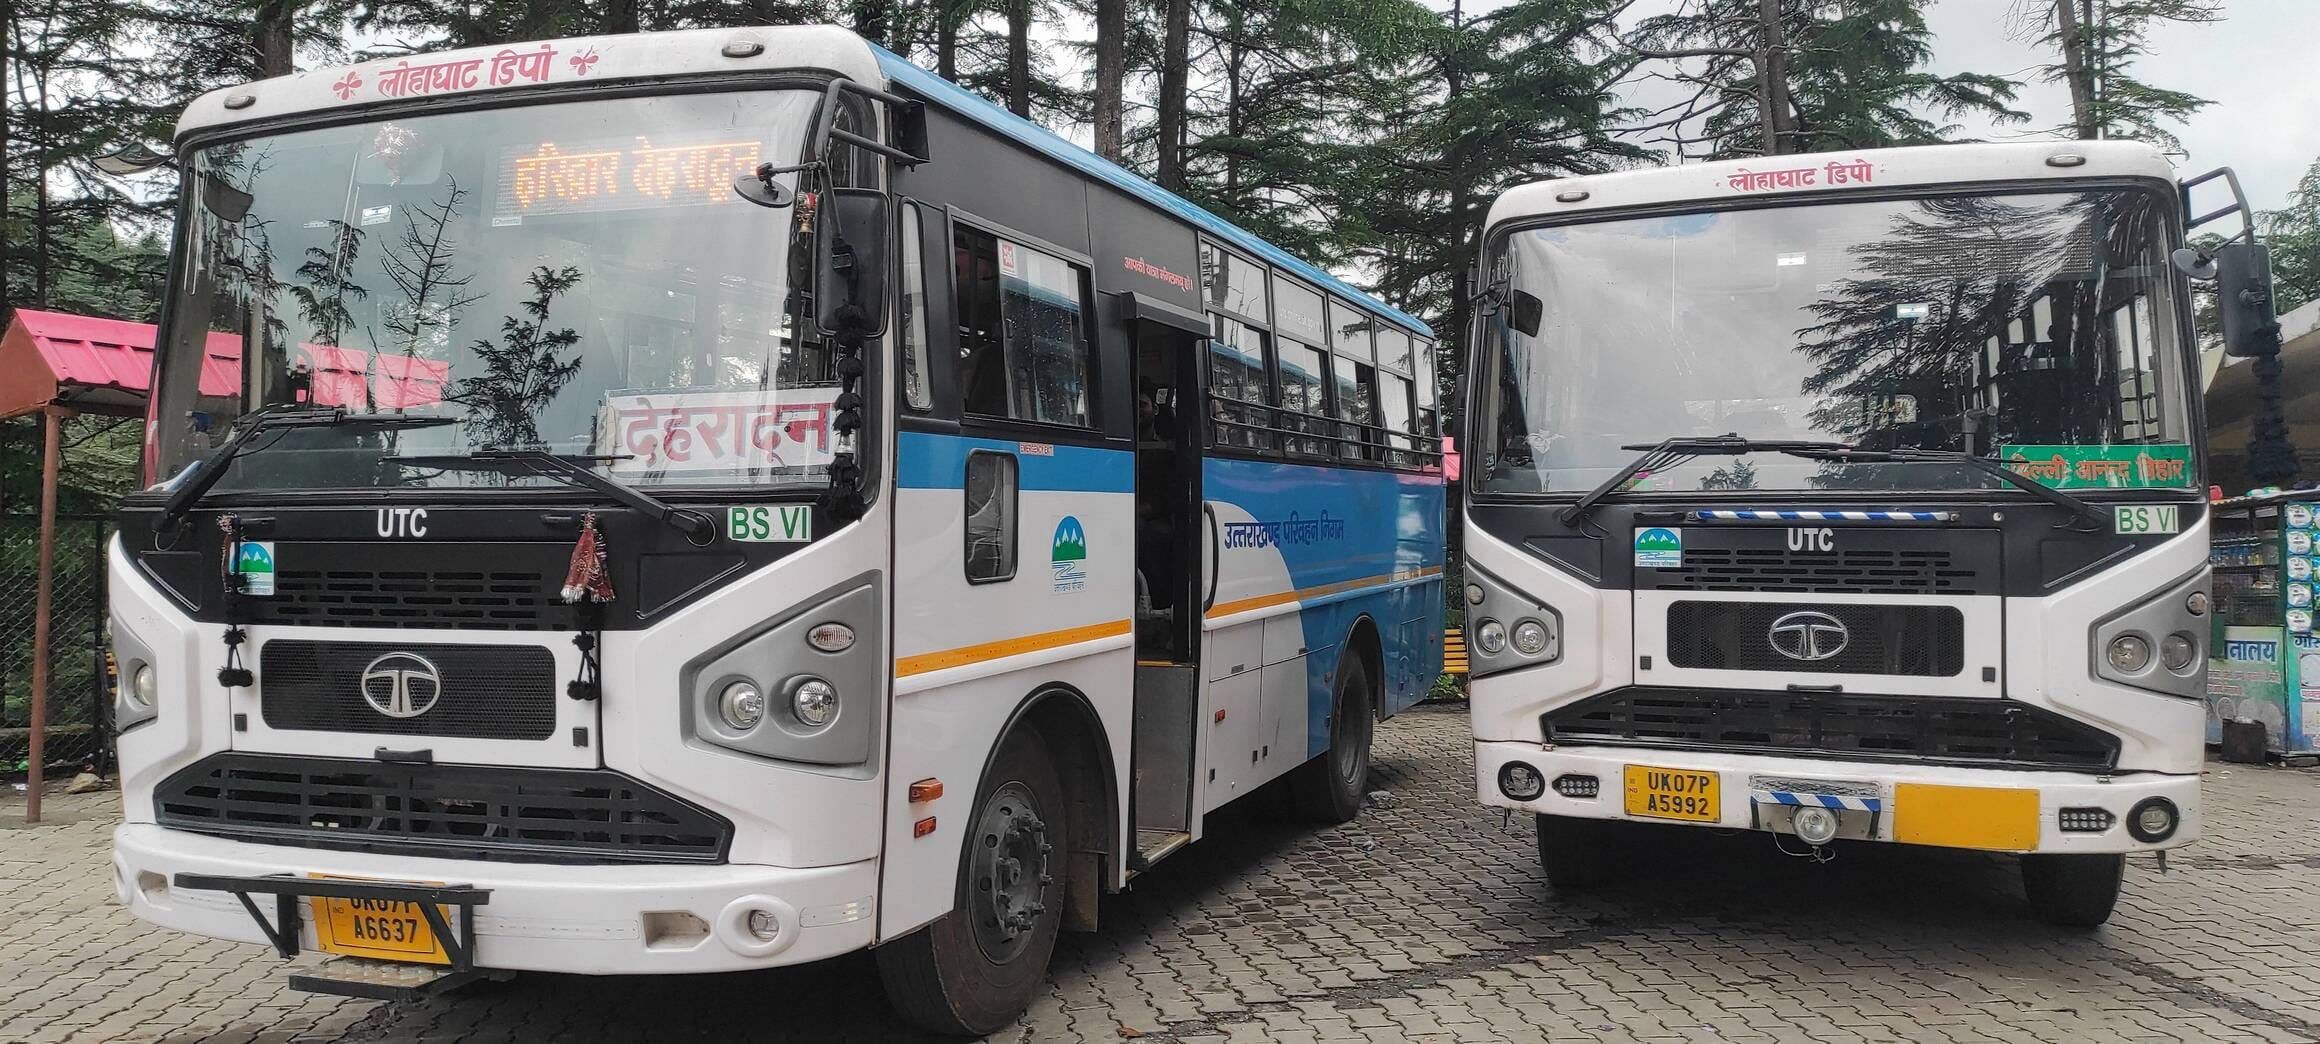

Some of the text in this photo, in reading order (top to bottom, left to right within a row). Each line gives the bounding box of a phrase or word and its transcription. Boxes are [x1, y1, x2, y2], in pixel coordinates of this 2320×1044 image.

[378, 44, 559, 97] लोहाघाट डिपो
[515, 143, 621, 208] हरिद्वार
[1727, 158, 1873, 192] लोहाघाट डिपो
[619, 397, 834, 468] देहरादून
[376, 508, 428, 538] UTC
[732, 507, 807, 540] BS VI
[1283, 510, 1319, 545] परिवहन
[1321, 509, 1344, 542] निगम
[2118, 507, 2177, 532] BS VI
[1787, 528, 1834, 551] UTC
[2223, 640, 2277, 662] नालय
[1647, 771, 1710, 794] UK07P
[1647, 794, 1709, 816] A5992
[354, 915, 418, 944] A6637
